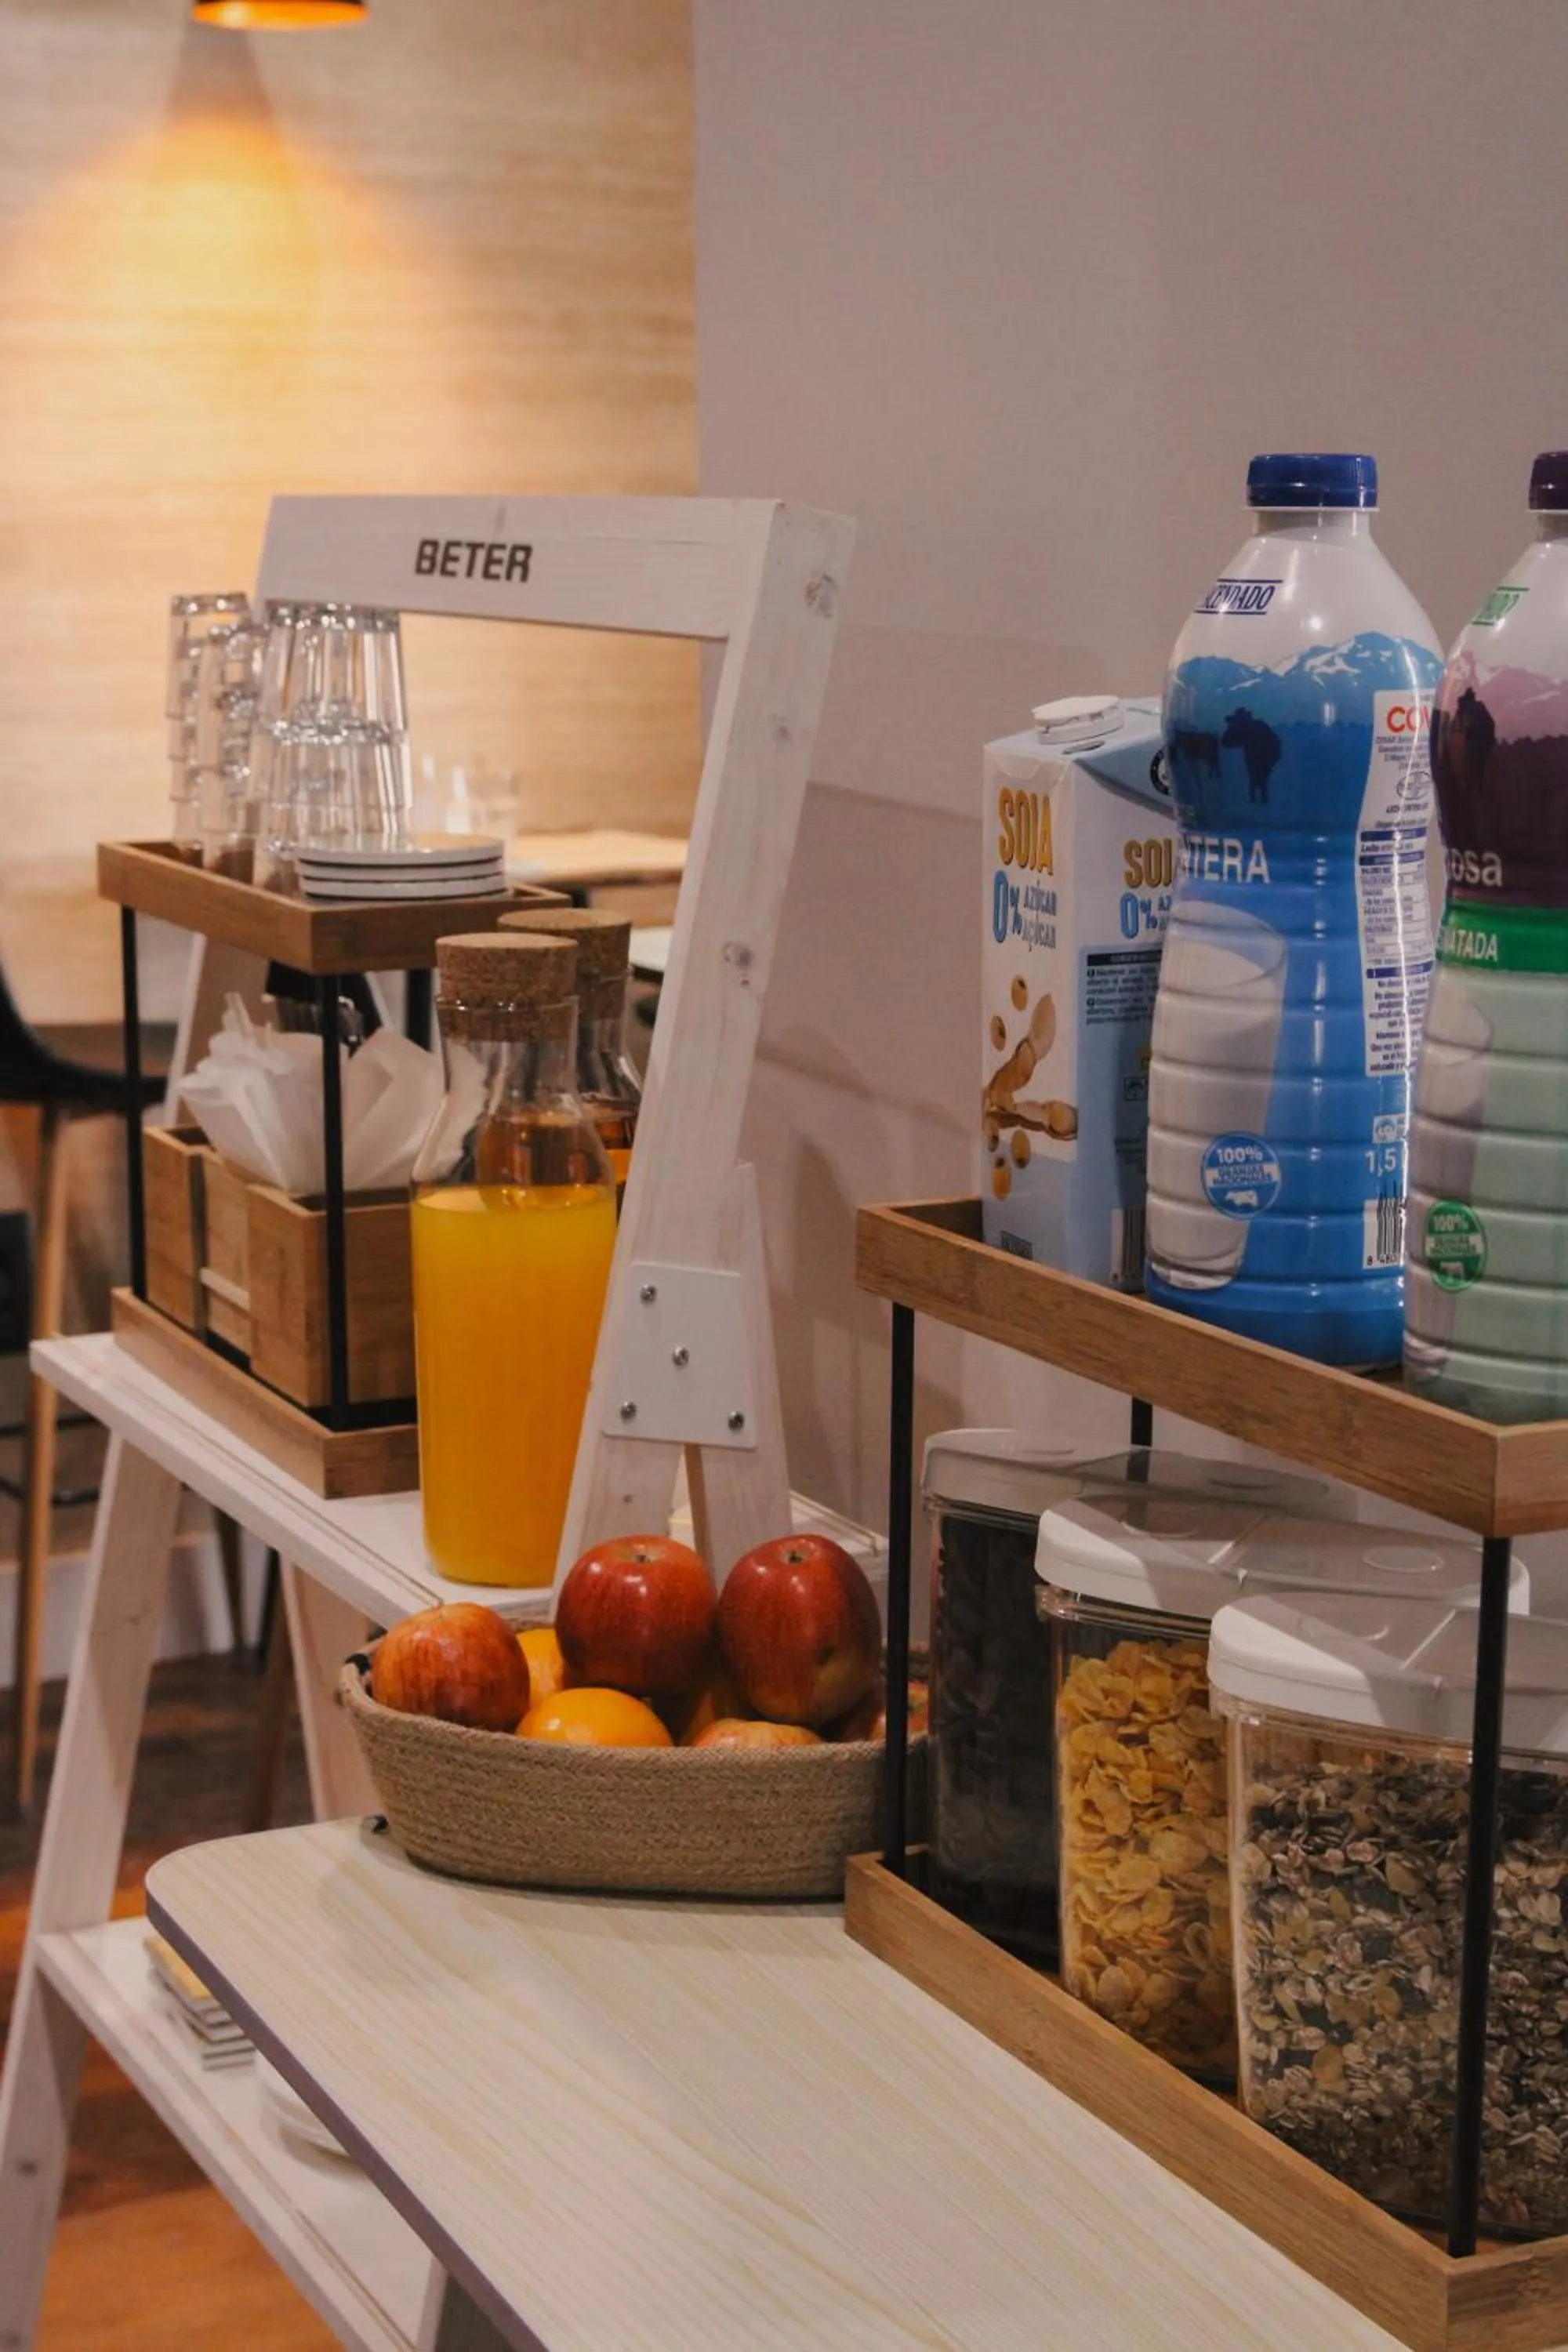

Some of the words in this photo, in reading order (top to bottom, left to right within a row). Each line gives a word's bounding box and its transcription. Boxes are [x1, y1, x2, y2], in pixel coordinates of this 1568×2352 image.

[415, 539, 533, 583] BETER
[1217, 1145, 1264, 1164] 100%
[1364, 1147, 1396, 1177] 1,5
[1433, 1214, 1469, 1232] 100%
